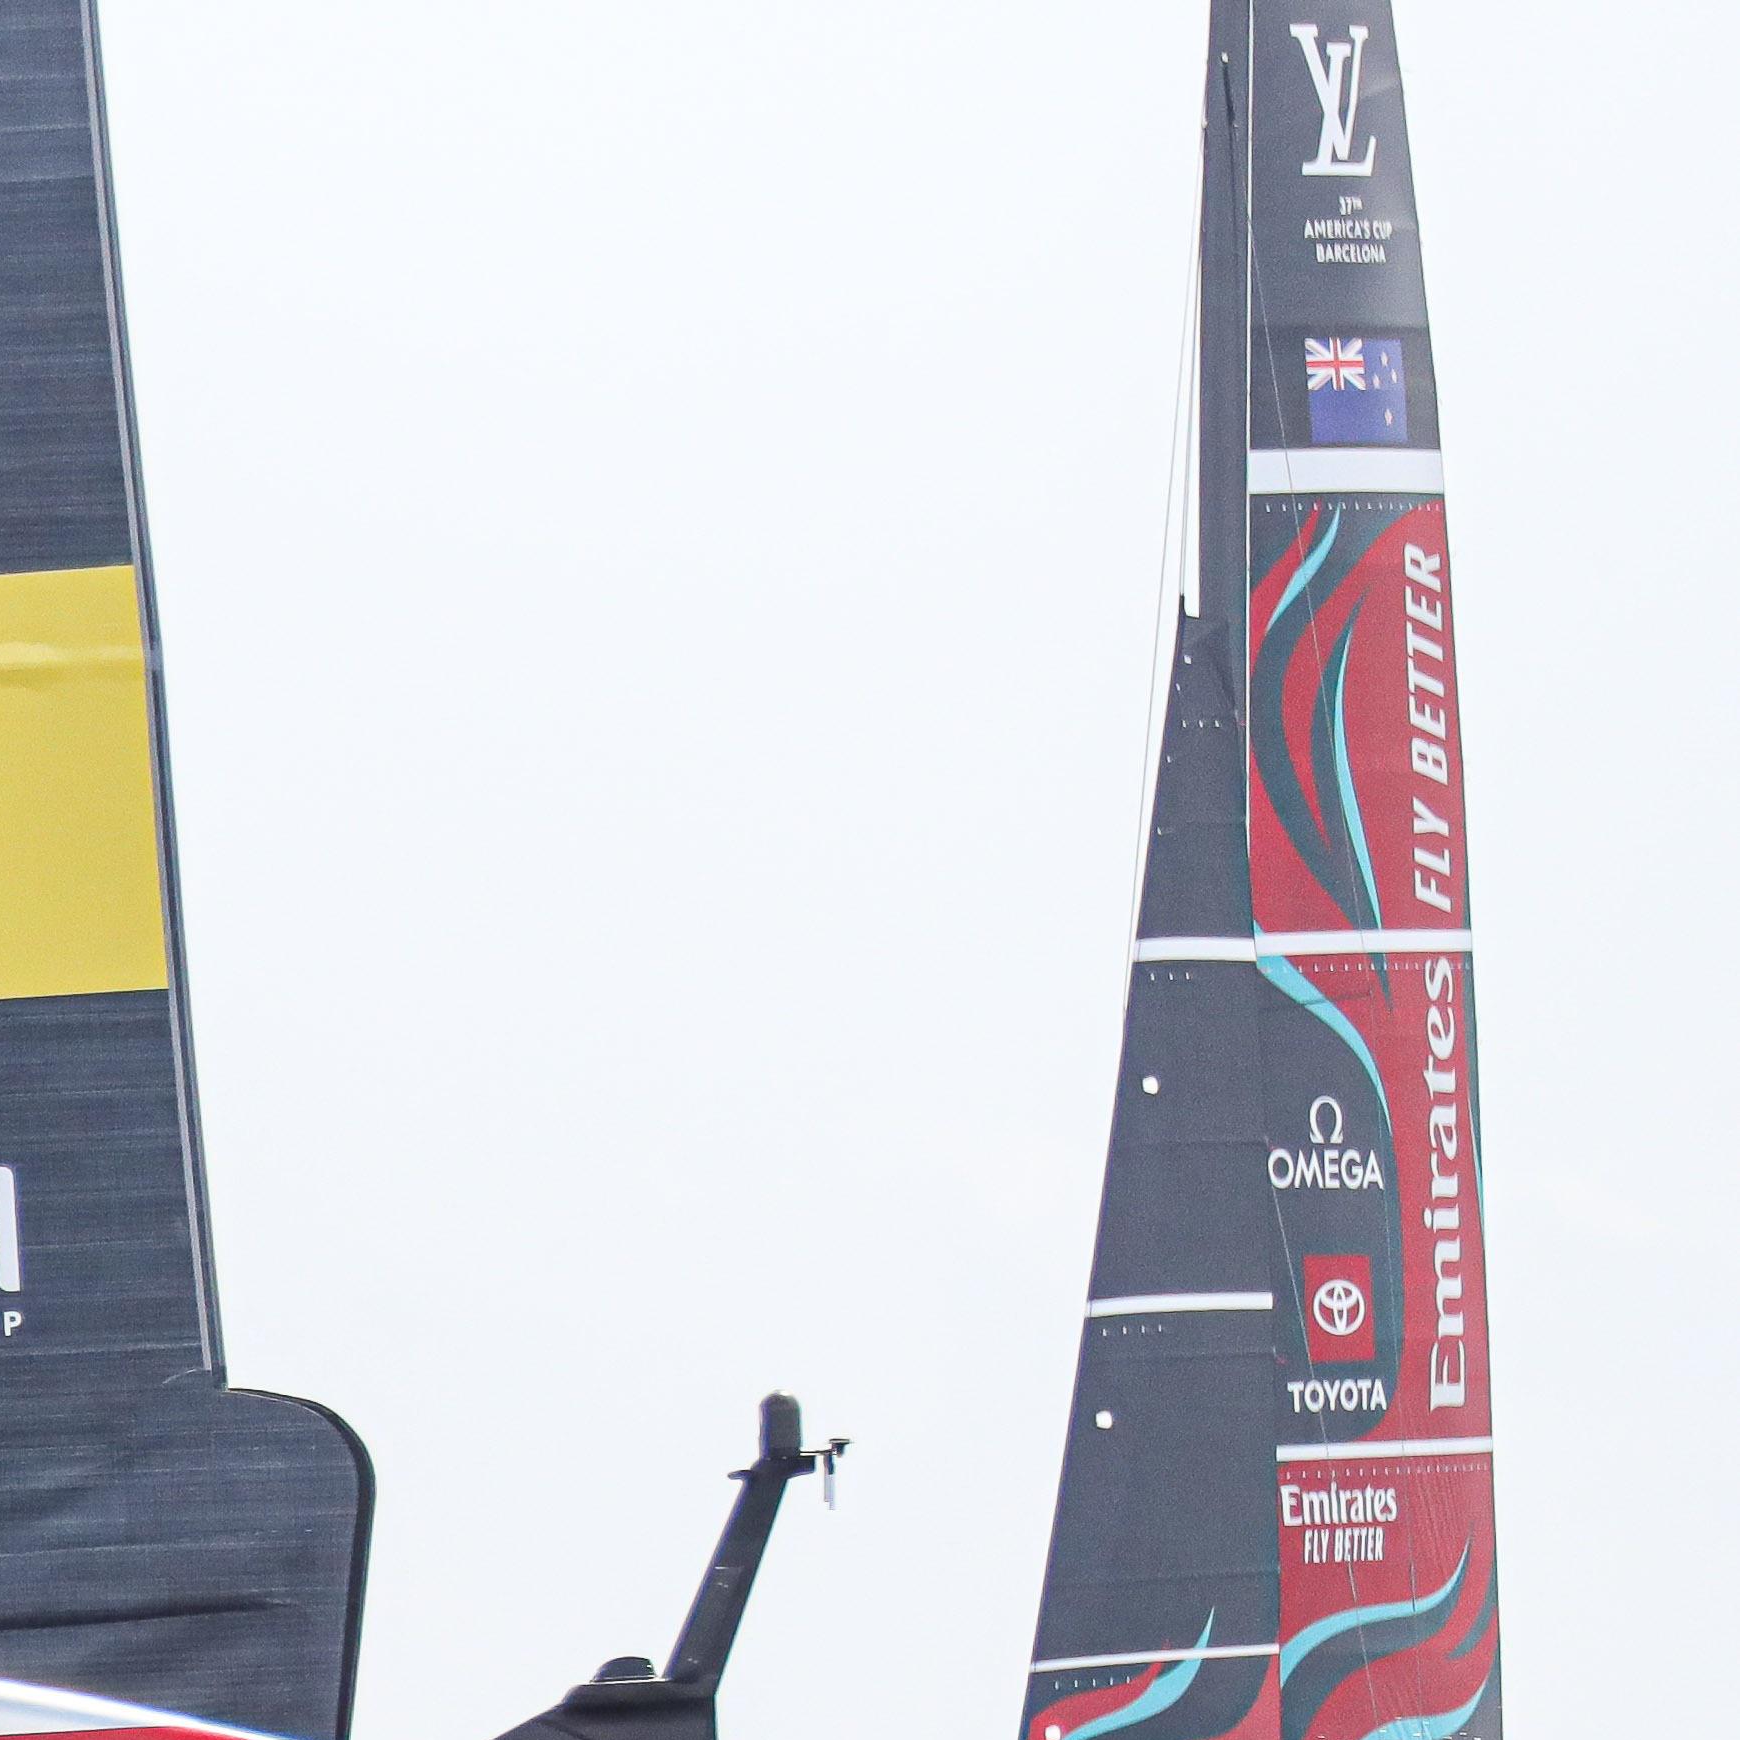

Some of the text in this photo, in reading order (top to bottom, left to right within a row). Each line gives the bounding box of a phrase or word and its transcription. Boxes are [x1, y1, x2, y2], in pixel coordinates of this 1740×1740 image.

[1315, 242, 1387, 264] BARCELONA
[1403, 542, 1453, 914] FLY BETTER
[1267, 1148, 1385, 1190] OMEGA
[1422, 955, 1466, 1413] Emirates
[1286, 1377, 1388, 1413] TOYOTA
[1279, 1481, 1398, 1527] Emirates
[1304, 1526, 1384, 1565] FLY BETTER
